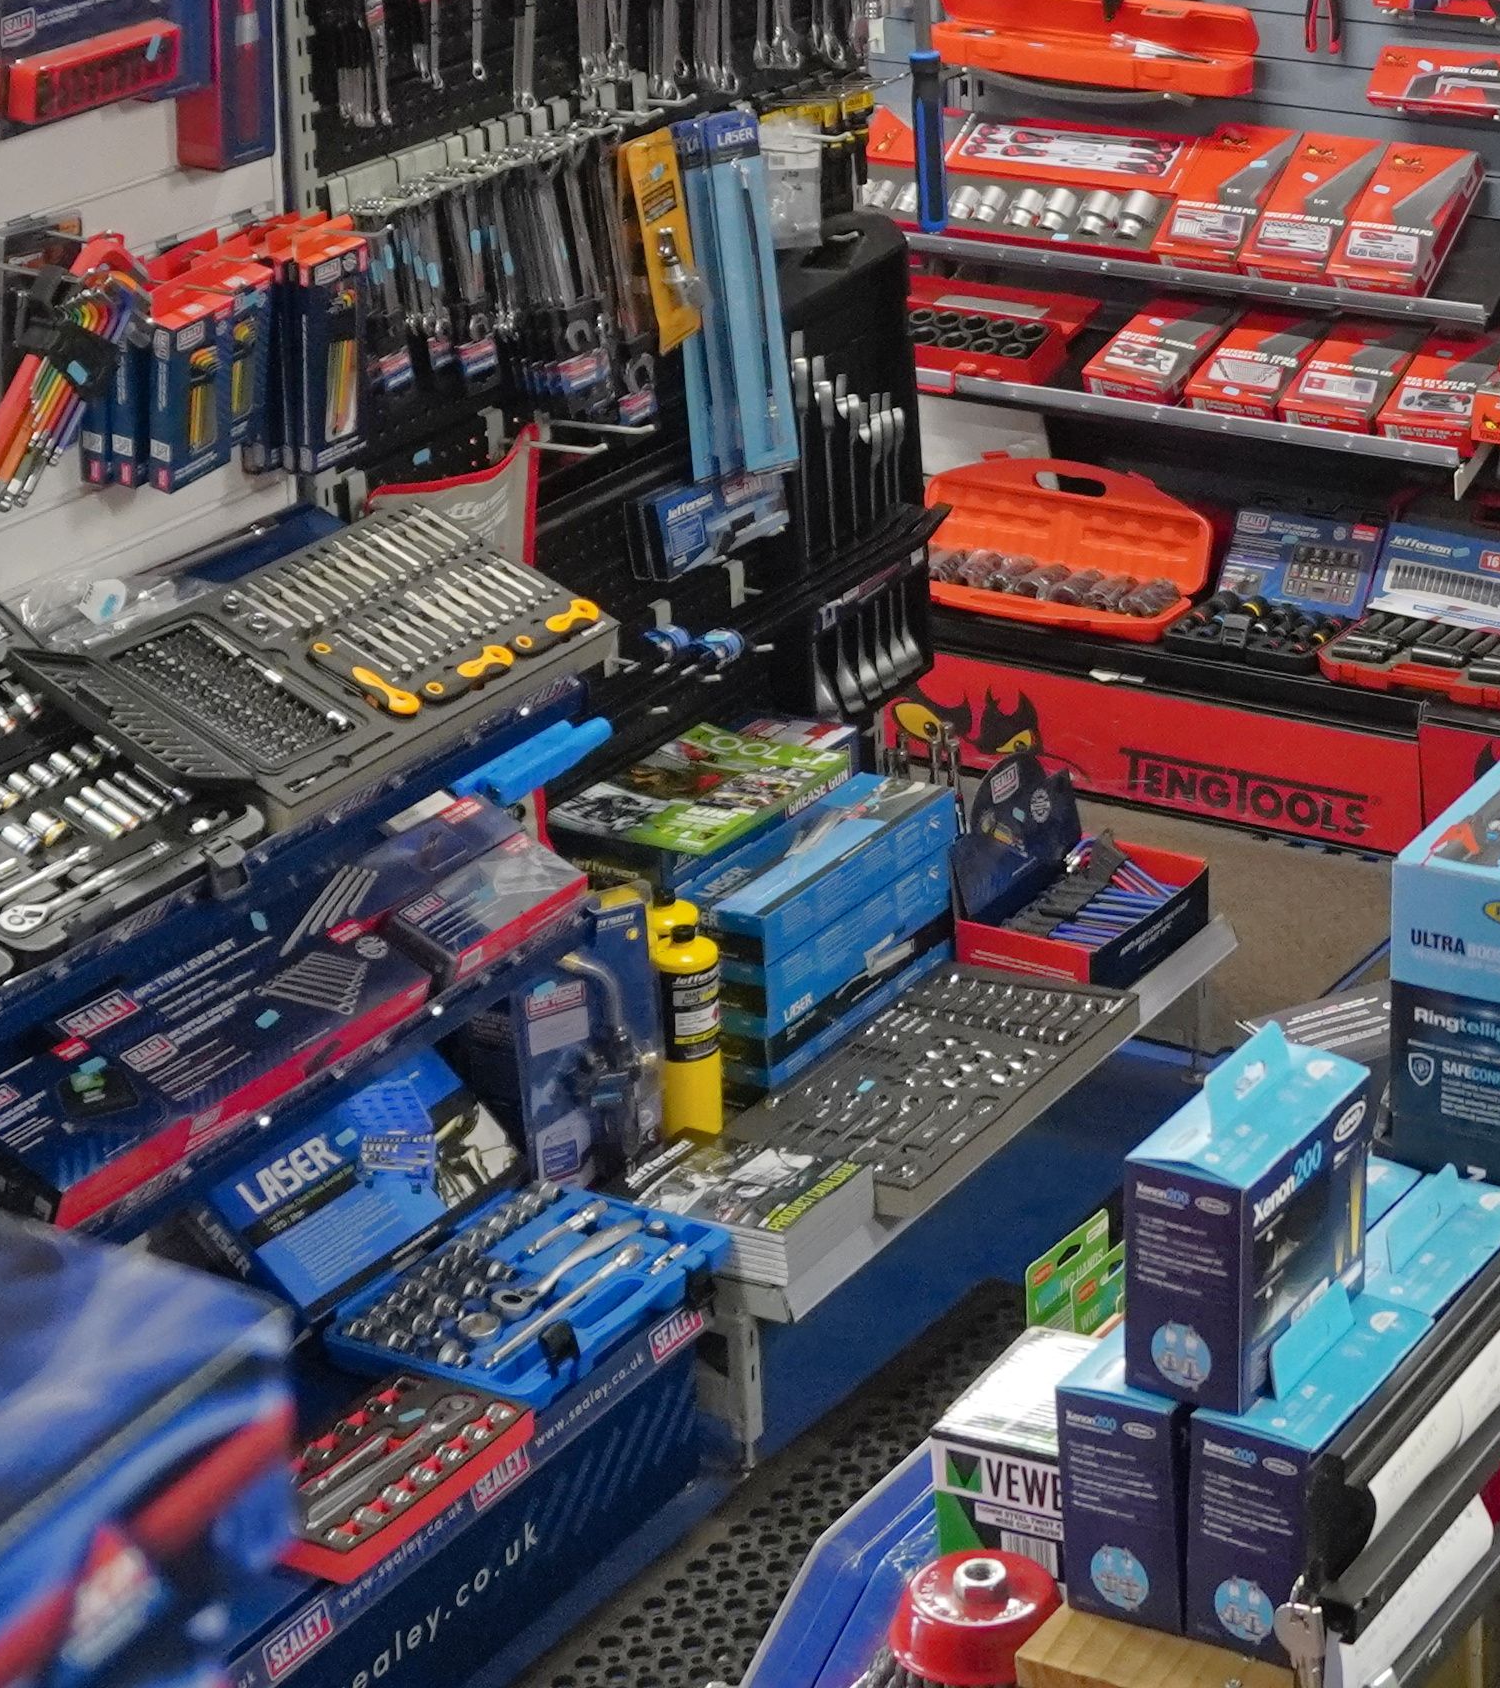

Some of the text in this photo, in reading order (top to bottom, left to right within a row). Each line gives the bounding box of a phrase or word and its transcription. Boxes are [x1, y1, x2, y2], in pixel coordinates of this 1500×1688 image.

[3, 13, 35, 38] SEALEY
[716, 128, 755, 147] LASER
[666, 492, 714, 518] Jefferson
[1240, 513, 1268, 527] SEALEY
[1390, 535, 1453, 557] Jefferson
[1486, 553, 1500, 568] 16
[700, 722, 788, 760] TOOL
[787, 769, 850, 815] GREASE GUN
[1119, 746, 1373, 839] TENGTOOLS
[404, 894, 444, 919] SEALEY
[1410, 928, 1466, 956] ULTRA
[154, 973, 182, 991] TYRE
[182, 953, 211, 977] LEVER
[65, 996, 130, 1032] SEALEY
[783, 994, 814, 1023] LASER
[126, 1037, 166, 1064] SEALEY
[235, 1133, 344, 1215] LASER
[625, 1138, 691, 1189] Jefferson
[1135, 1181, 1190, 1206] Xenon200
[1253, 1140, 1323, 1228] Xenon200
[768, 1195, 810, 1233] PRODUCT
[200, 1212, 253, 1276] LASER
[474, 1313, 701, 1506] SEALEY www.sealey.co.uk SEALEY
[1065, 1410, 1118, 1432] Xenon200
[1202, 1438, 1257, 1464] Xenon200
[267, 1500, 464, 1674] SEALEY www.sealey.co.uk
[348, 1520, 540, 1688] ealey.co.uk
